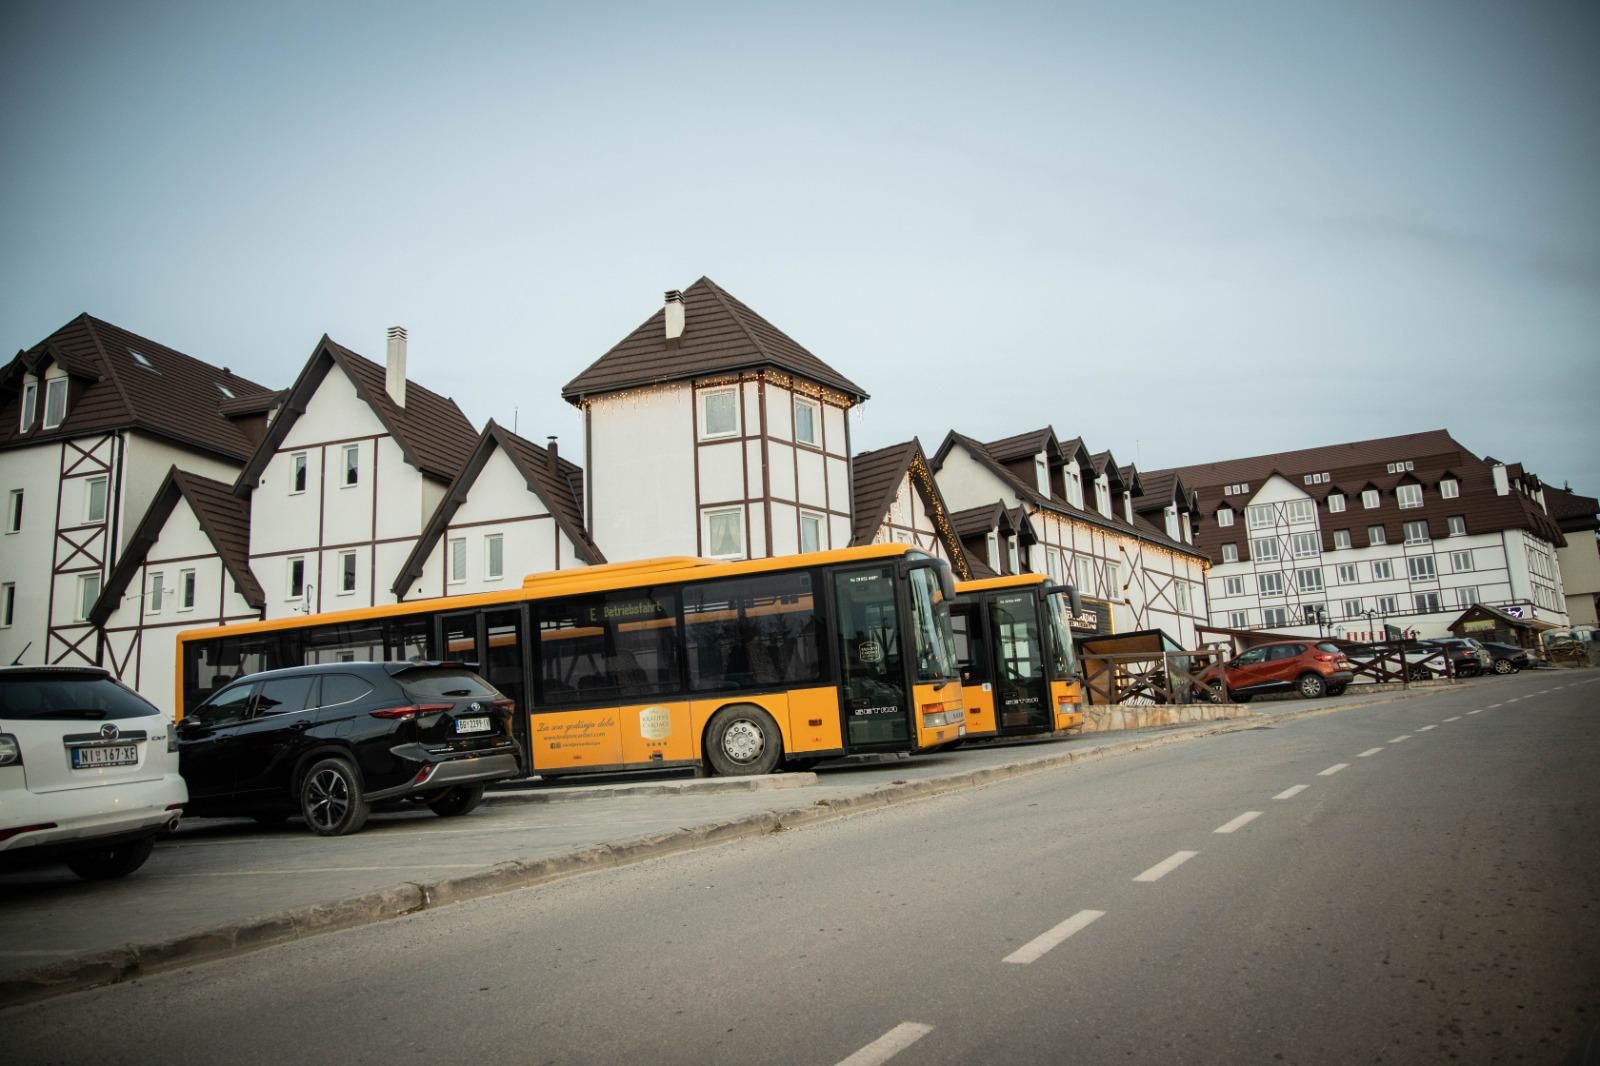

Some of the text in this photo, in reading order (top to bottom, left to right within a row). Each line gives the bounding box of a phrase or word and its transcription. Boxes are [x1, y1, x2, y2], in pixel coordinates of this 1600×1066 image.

[590, 600, 662, 621] E Betriebsfahrt
[81, 749, 94, 763] NI
